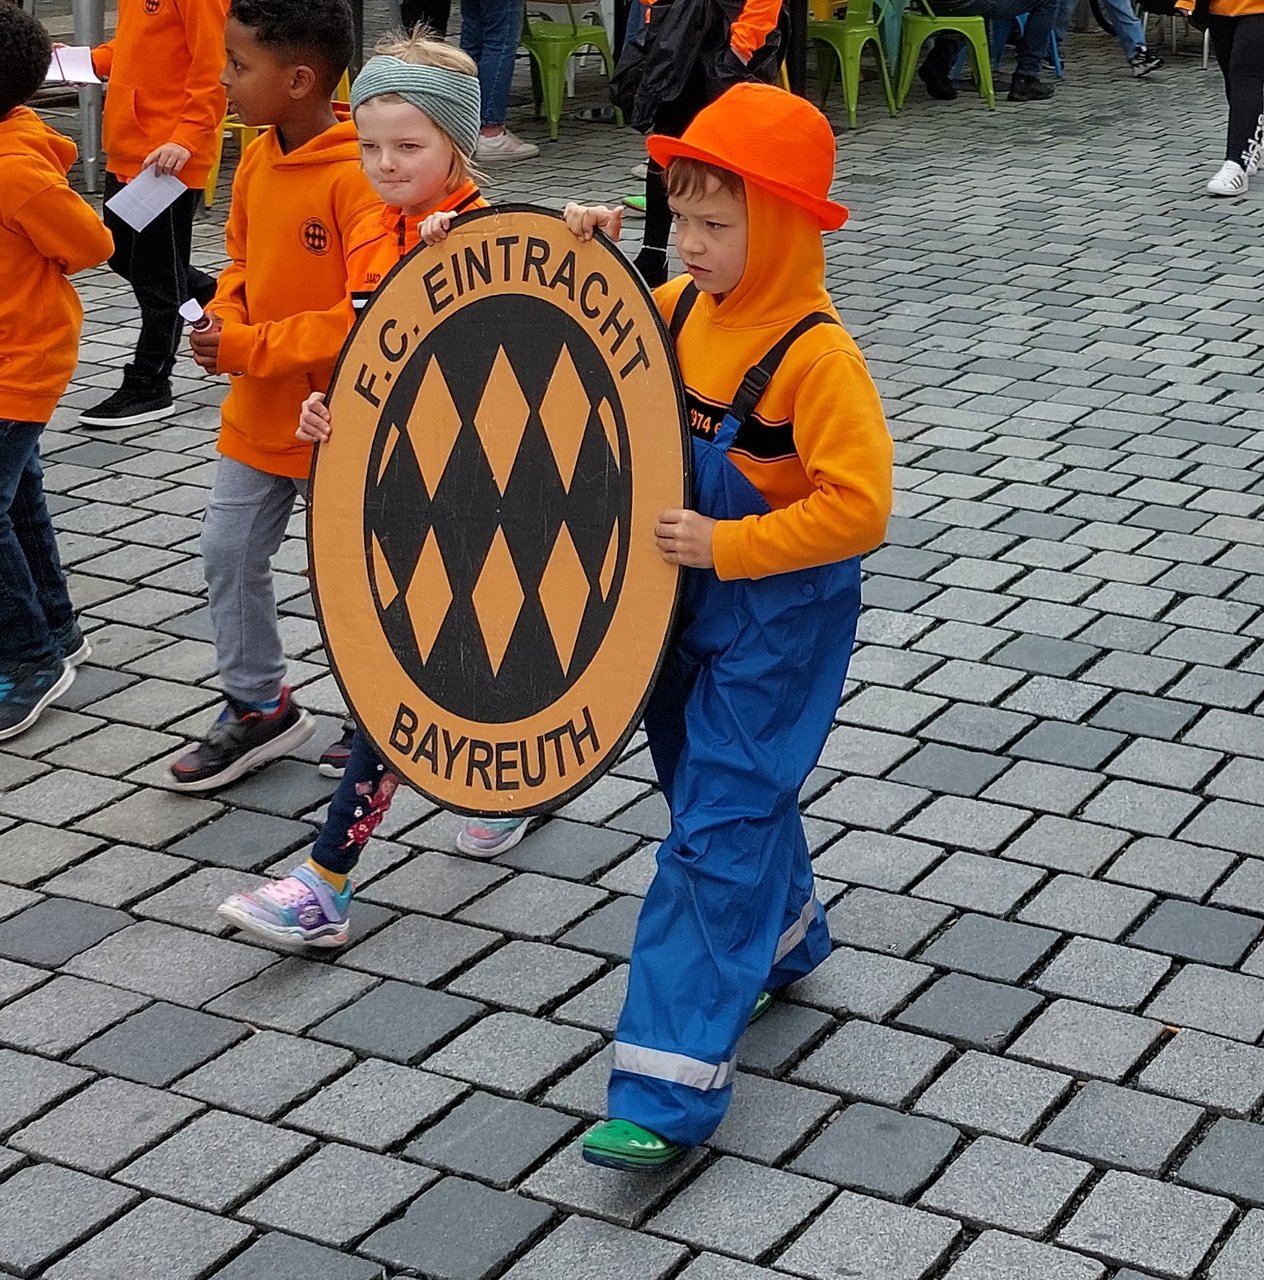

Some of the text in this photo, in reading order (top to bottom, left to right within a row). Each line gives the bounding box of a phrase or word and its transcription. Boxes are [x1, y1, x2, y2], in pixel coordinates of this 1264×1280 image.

[353, 235, 651, 409] F.C. EINTRACHT
[388, 702, 601, 792] BAYREUTH
